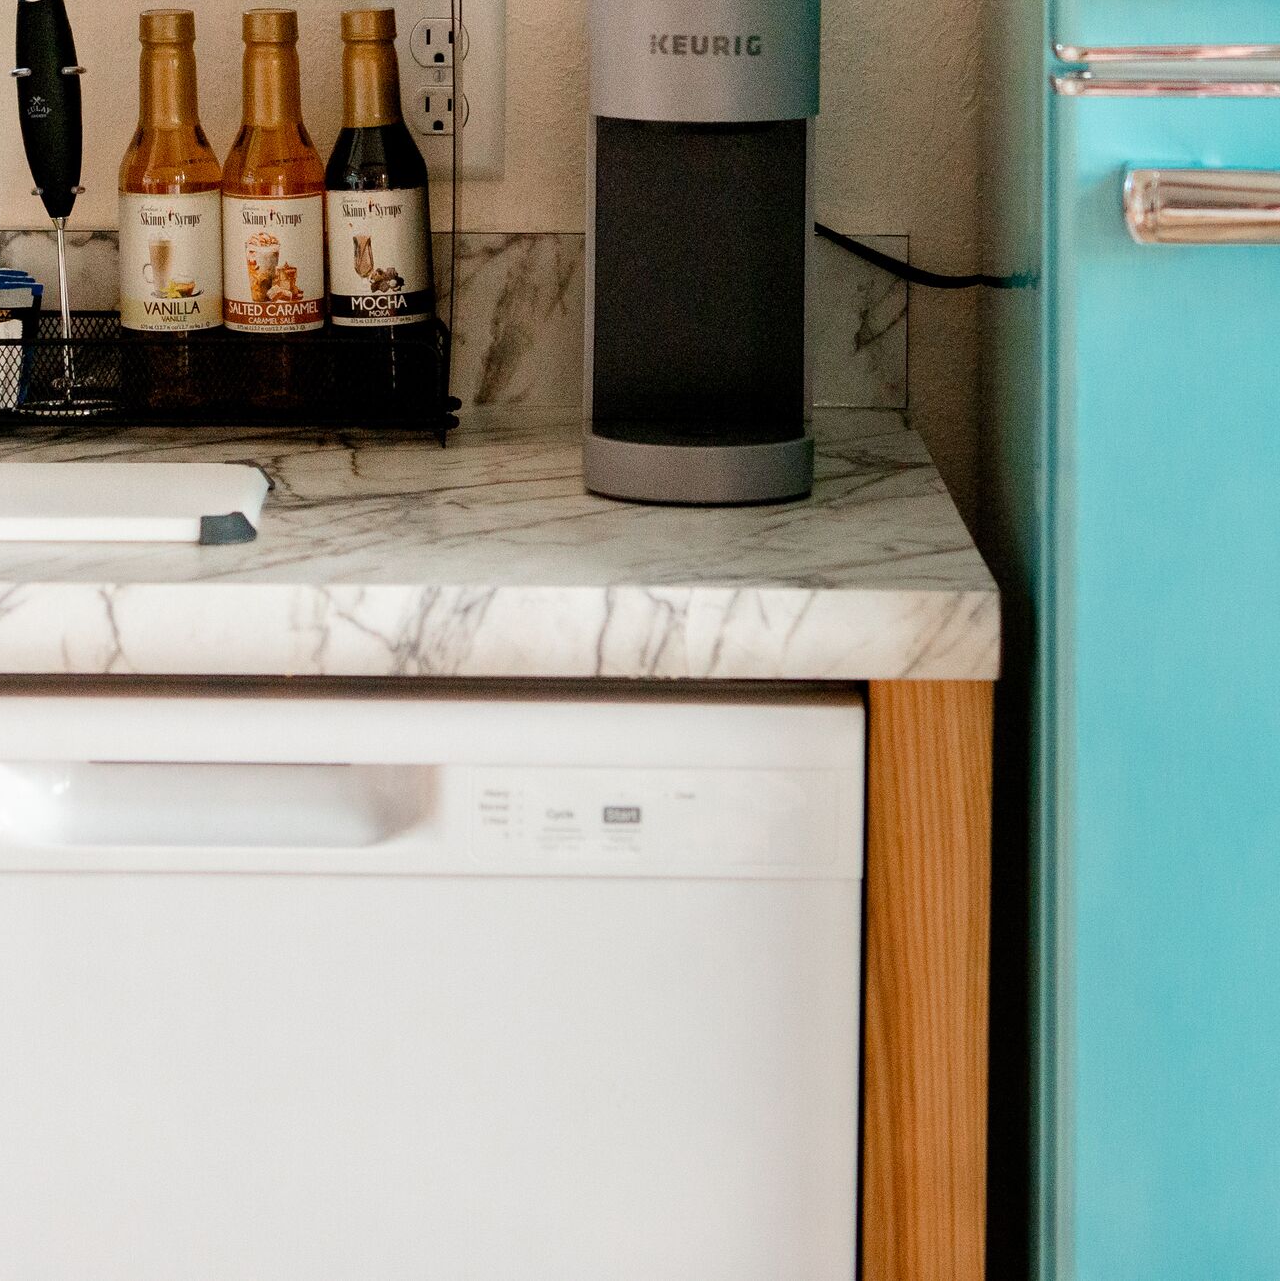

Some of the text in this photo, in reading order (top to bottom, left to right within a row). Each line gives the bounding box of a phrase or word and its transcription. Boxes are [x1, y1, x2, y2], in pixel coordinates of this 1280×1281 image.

[649, 34, 763, 56] KEURIG
[242, 211, 302, 227] Skinny Syrups
[342, 203, 402, 220] Skinny Syrups
[141, 213, 200, 228] Skinny Syrups
[144, 301, 200, 315] VANILLA
[229, 301, 318, 316] SALTED CARAMEL
[351, 295, 407, 310] MOCHA
